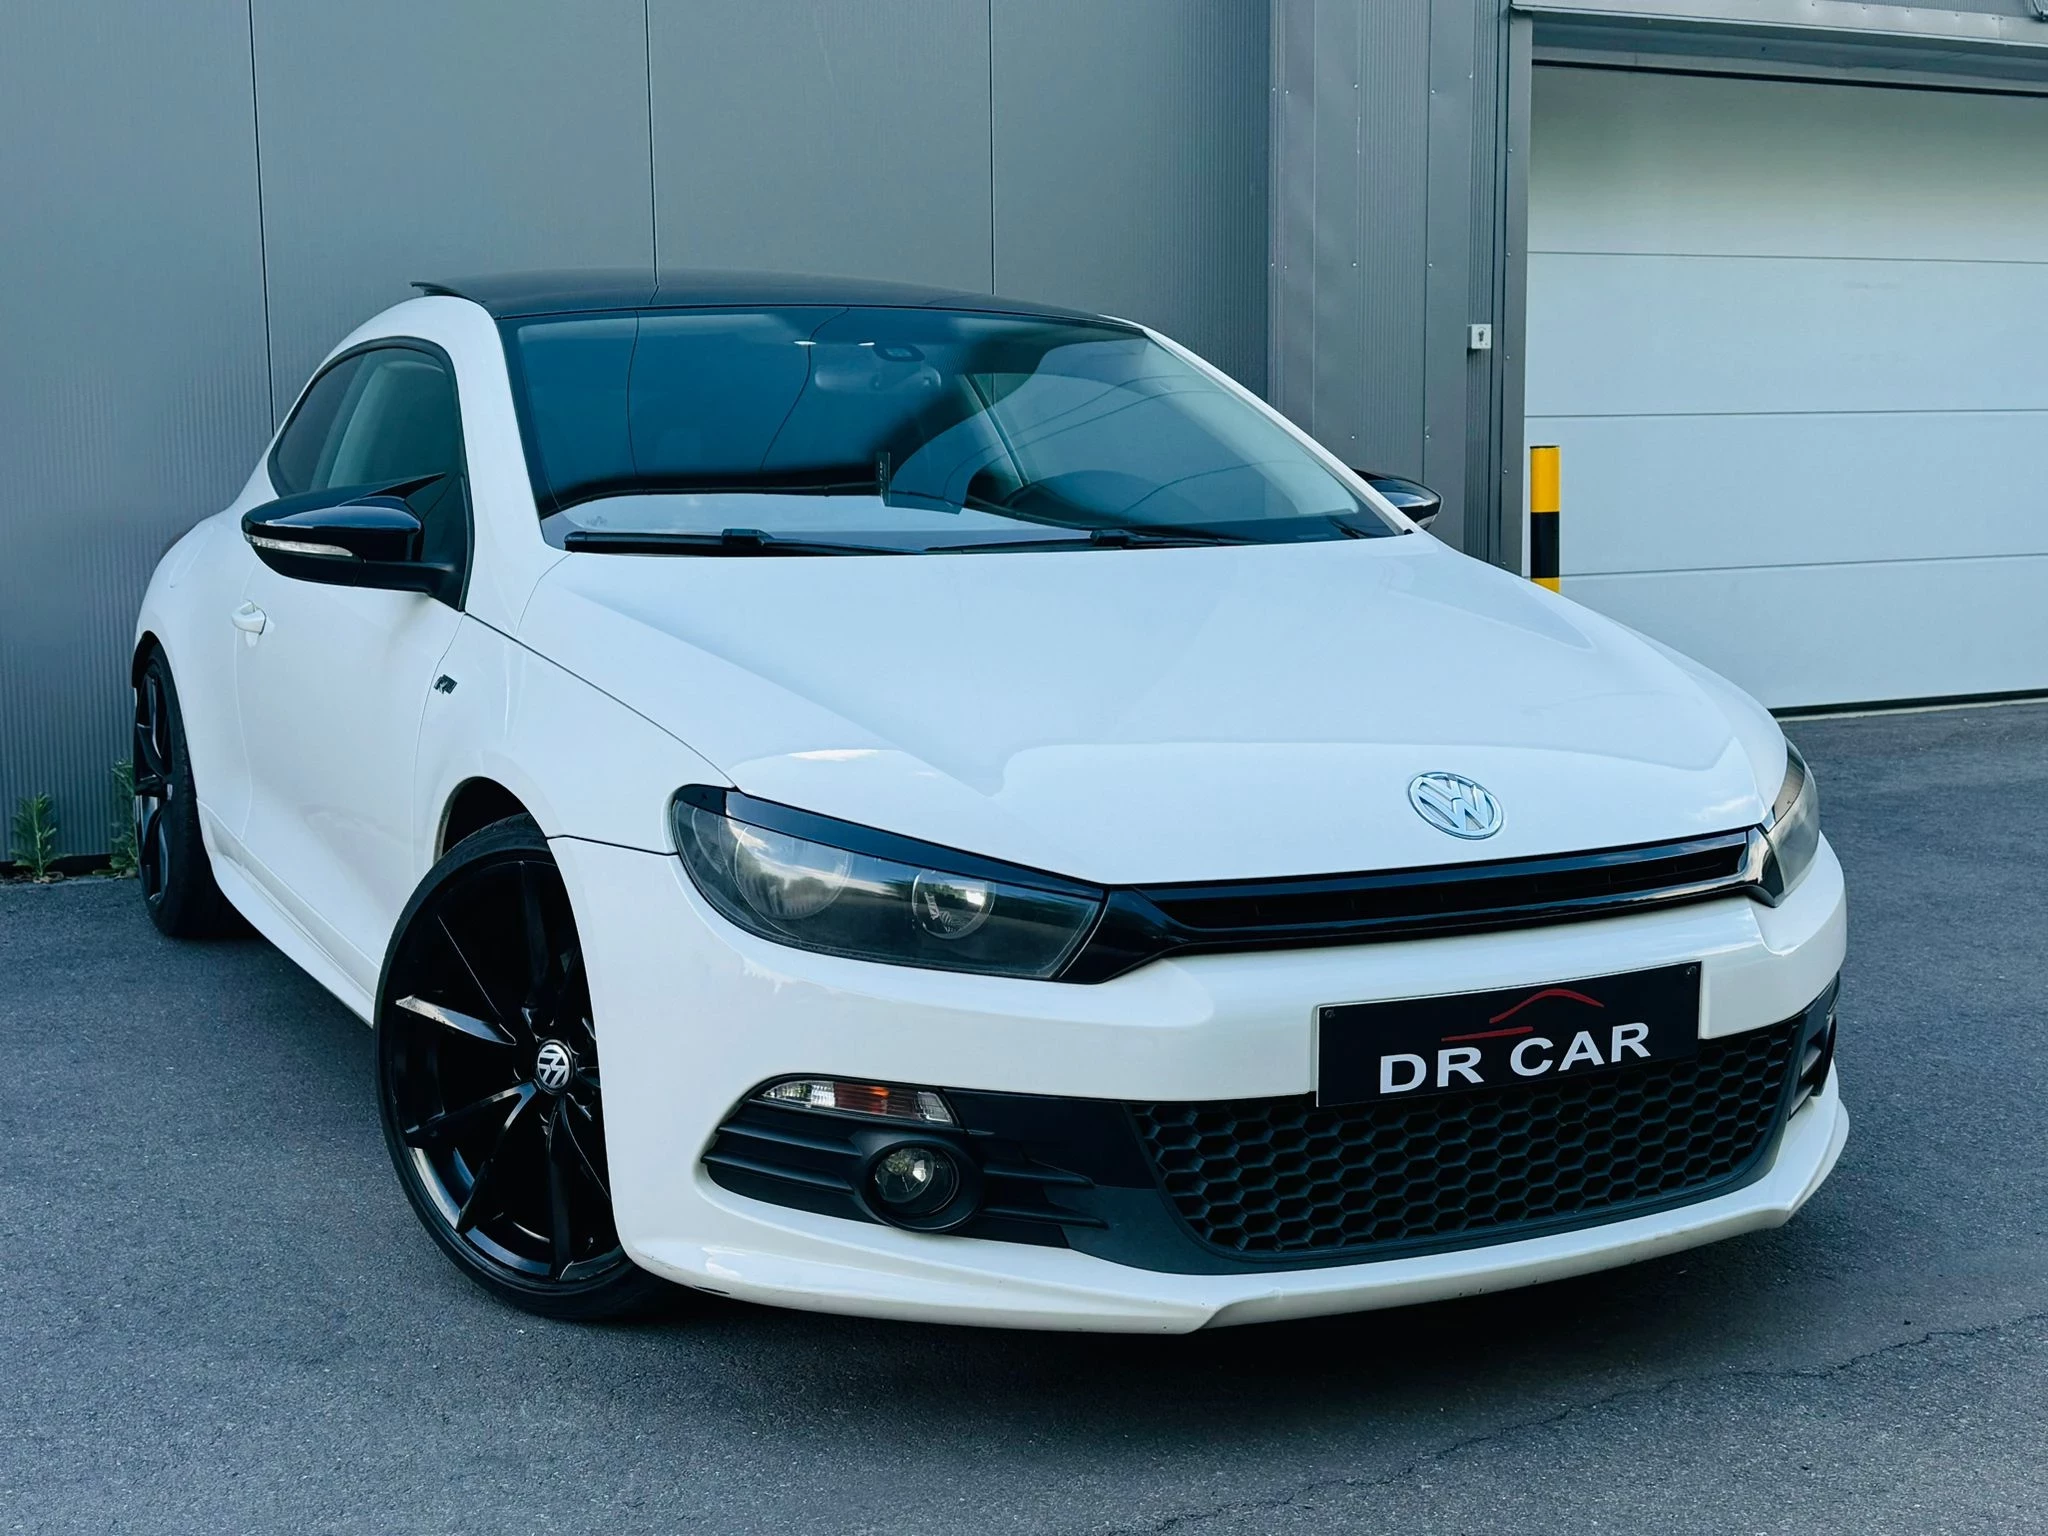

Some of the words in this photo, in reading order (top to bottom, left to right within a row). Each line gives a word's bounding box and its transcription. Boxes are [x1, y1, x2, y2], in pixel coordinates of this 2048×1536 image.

[1410, 772, 1501, 839] VW
[1380, 1046, 1485, 1094] DR
[1510, 1022, 1652, 1077] CAR
